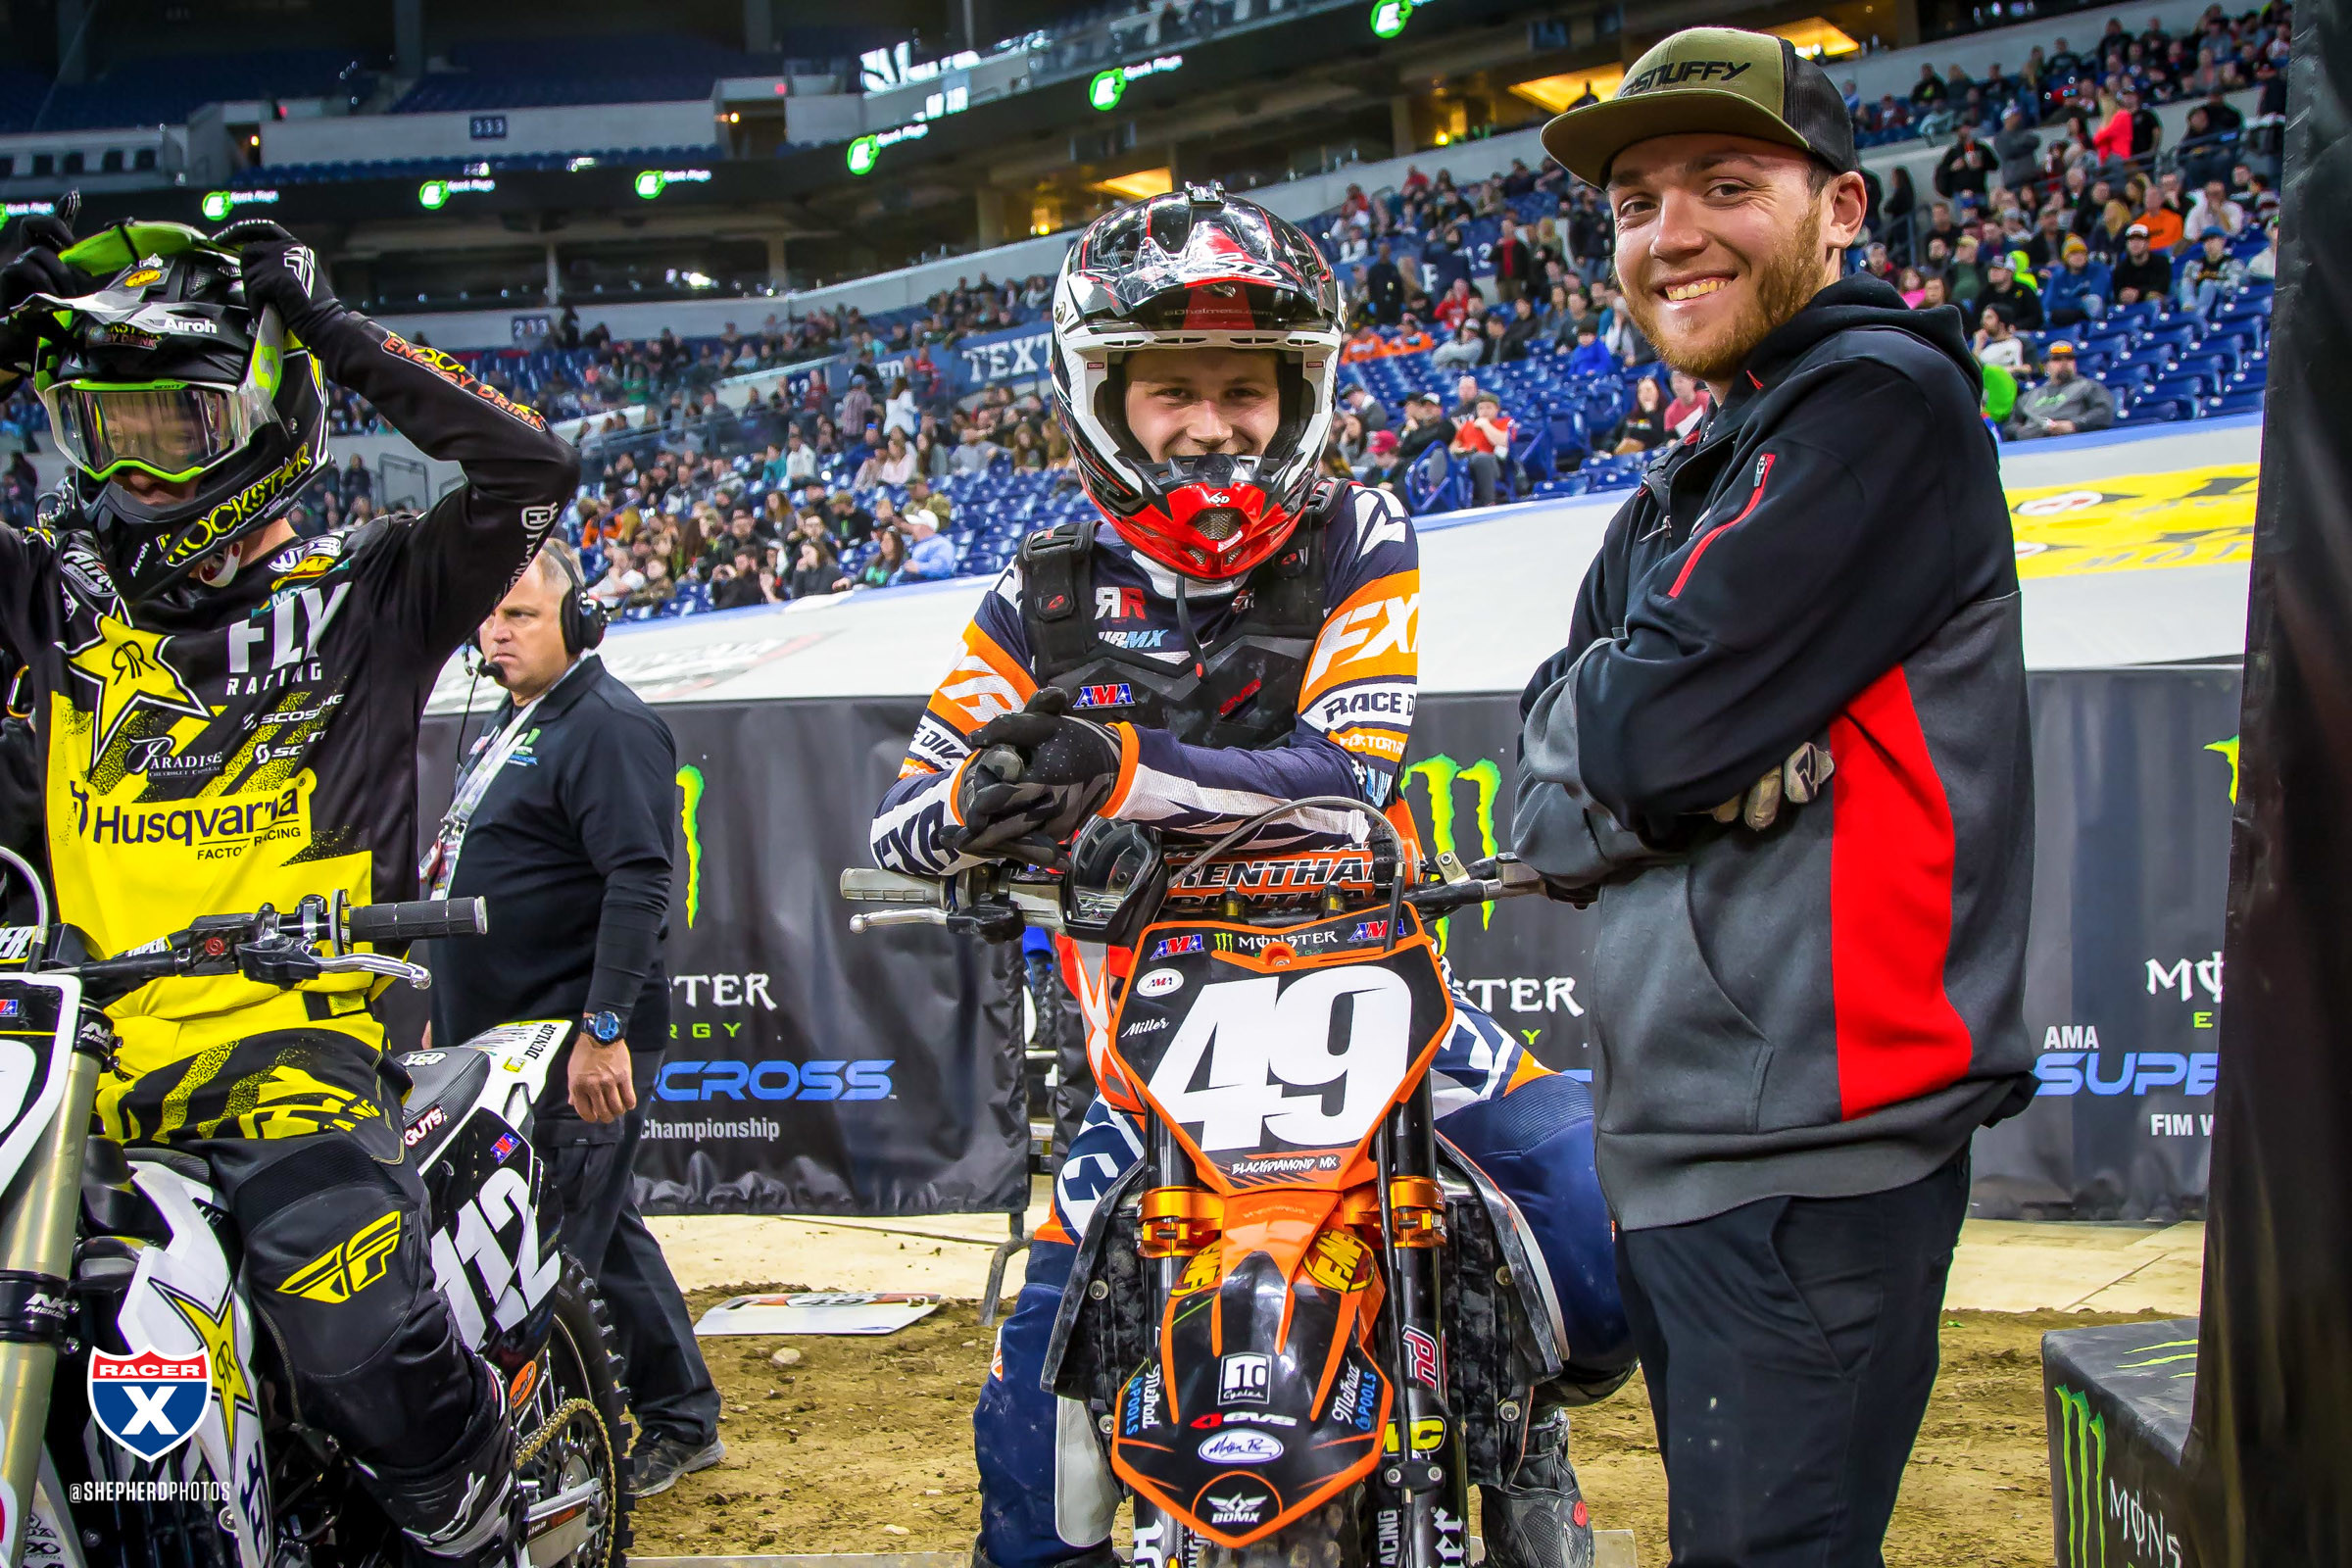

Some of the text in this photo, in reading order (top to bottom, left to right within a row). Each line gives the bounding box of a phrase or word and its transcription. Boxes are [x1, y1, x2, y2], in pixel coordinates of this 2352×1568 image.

[164, 318, 218, 333] Airoh
[476, 383, 543, 429] DRINK
[228, 581, 353, 674] FLY
[1304, 592, 1419, 693] FX
[1073, 683, 1136, 710] AMA
[1323, 692, 1401, 723] RACE
[1169, 858, 1373, 889] RENTHA
[1150, 934, 1204, 960] AMA
[1239, 931, 1340, 952] MONSTER
[523, 1023, 557, 1060] DUNLOP
[1120, 1017, 1170, 1039] Miller
[2043, 1025, 2100, 1050] AMA
[1148, 965, 1412, 1152] 49
[2033, 1052, 2220, 1097] SUPE
[404, 1106, 444, 1148] GUTS
[641, 1117, 780, 1142] Championship
[2150, 1114, 2193, 1136] FIM
[1319, 1155, 1338, 1168] MX
[1360, 1372, 1377, 1420] POOLS
[1377, 1509, 1399, 1566] ACING
